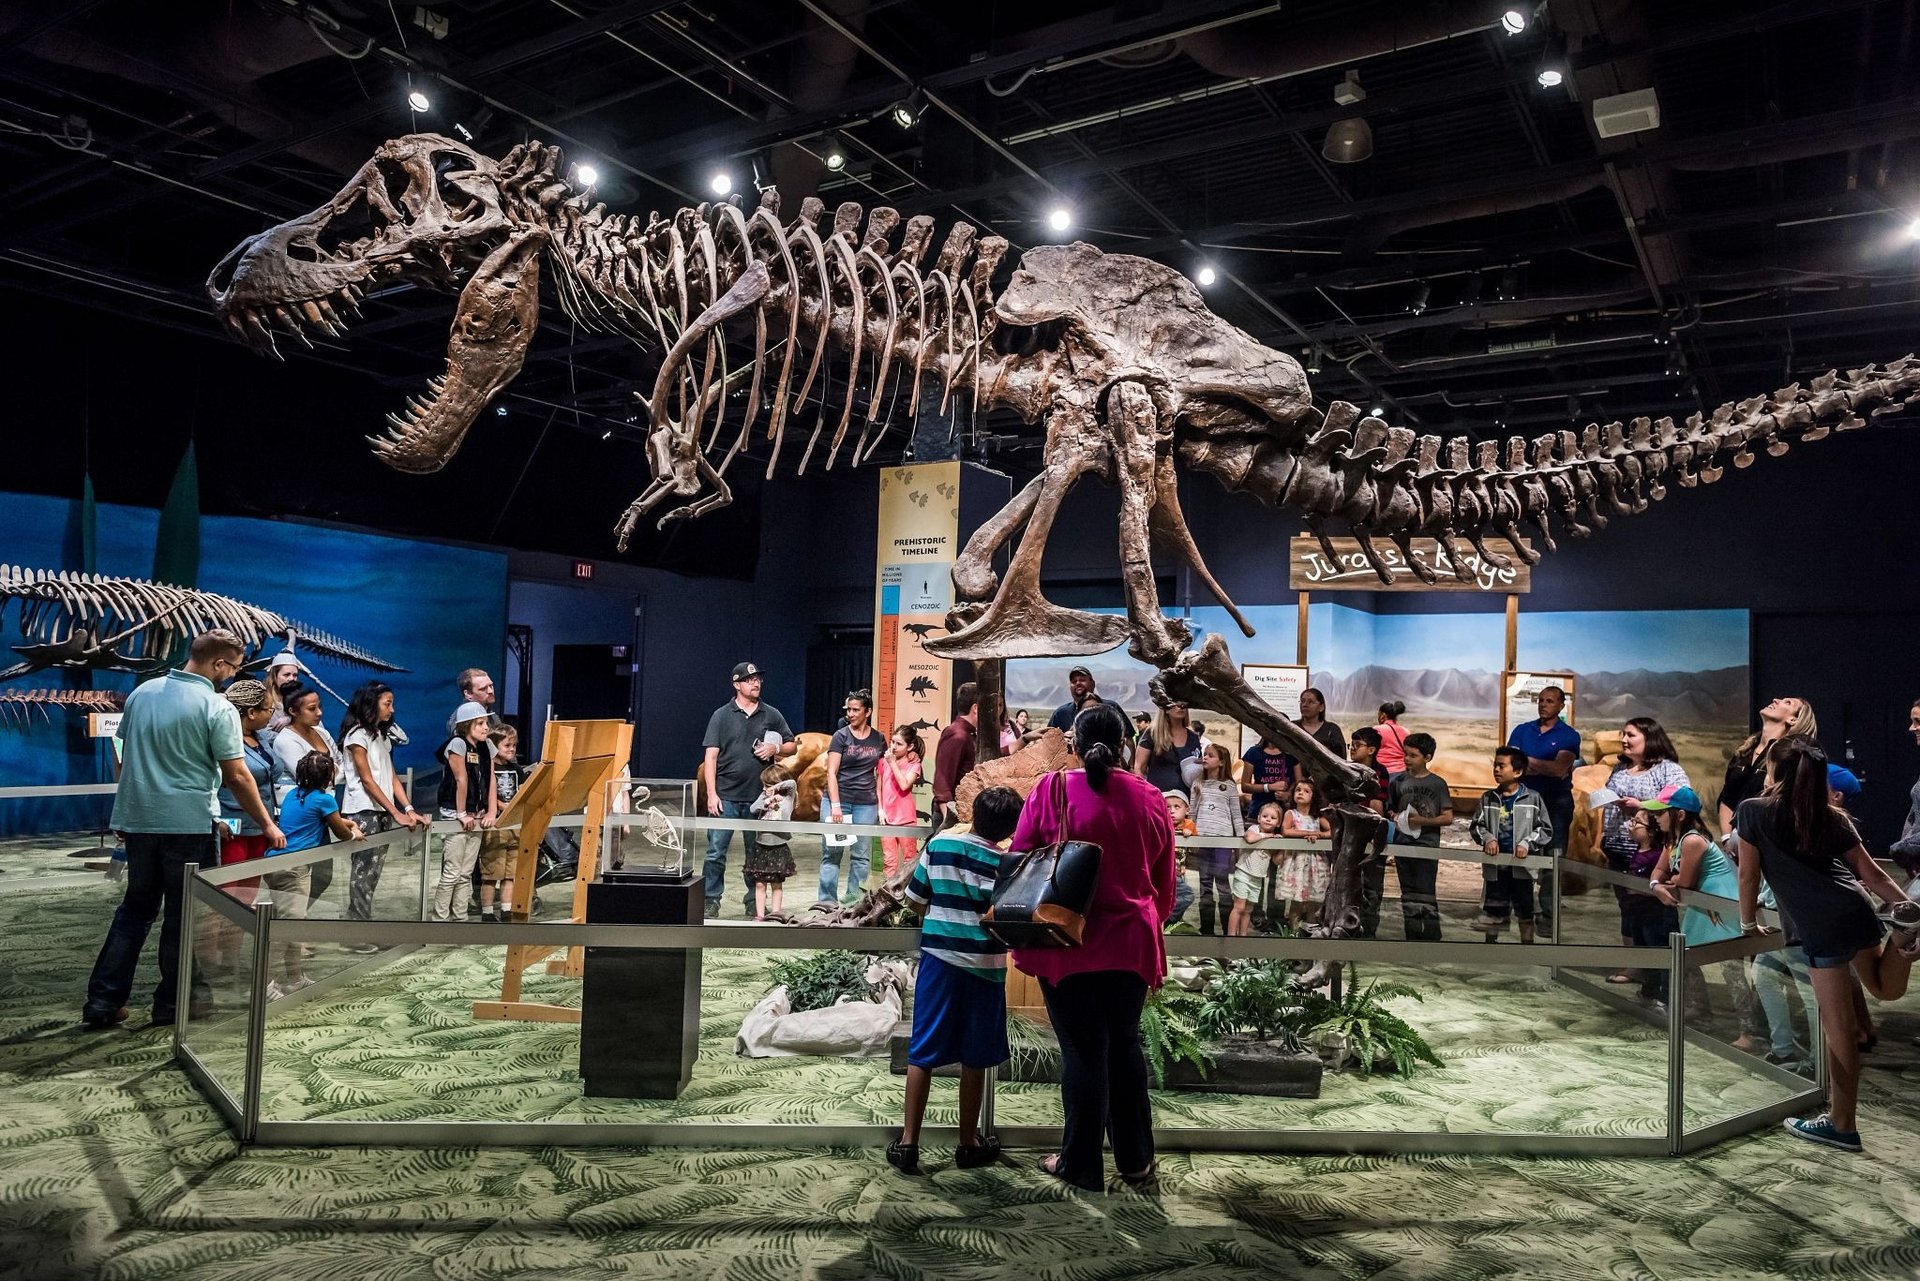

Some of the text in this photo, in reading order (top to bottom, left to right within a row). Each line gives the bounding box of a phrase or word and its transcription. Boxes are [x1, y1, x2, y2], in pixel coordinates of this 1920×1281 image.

[894, 537, 946, 546] PREHISTORIC
[902, 548, 938, 556] TIMELINE
[578, 564, 592, 578] EXIT
